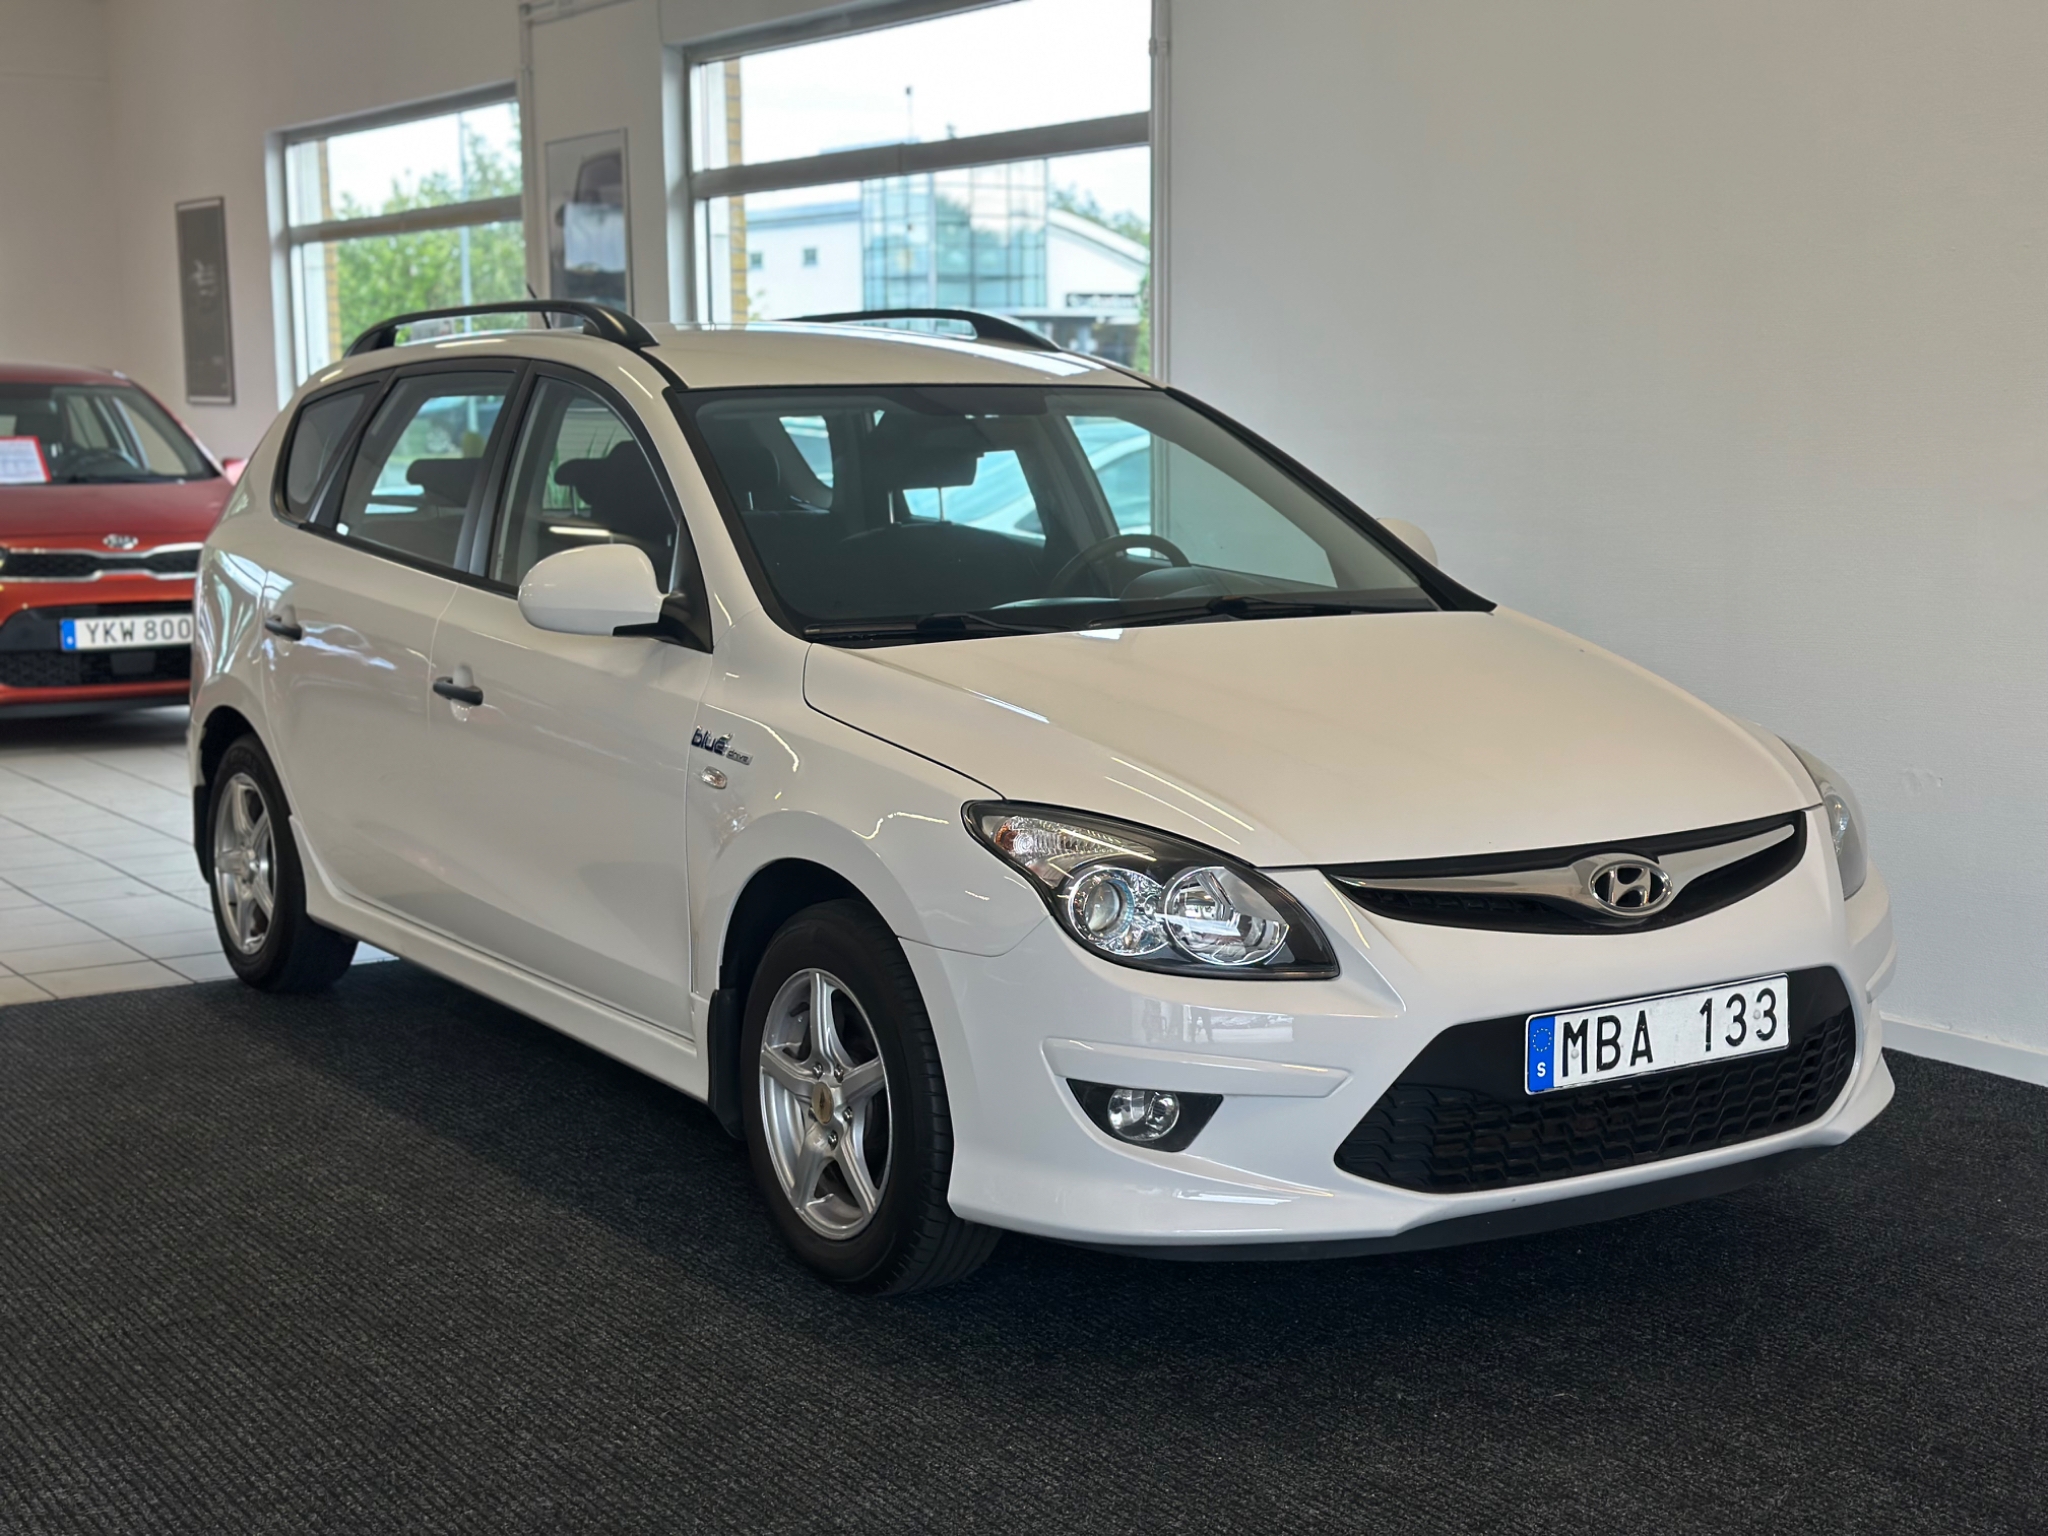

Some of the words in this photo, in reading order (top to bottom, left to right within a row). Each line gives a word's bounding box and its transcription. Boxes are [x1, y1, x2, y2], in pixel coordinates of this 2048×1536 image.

[86, 621, 135, 644] YKW
[144, 618, 192, 641] 800
[691, 726, 727, 756] blue
[1536, 1062, 1547, 1078] S
[1562, 1010, 1654, 1078] MBA
[1699, 987, 1778, 1053] 133
